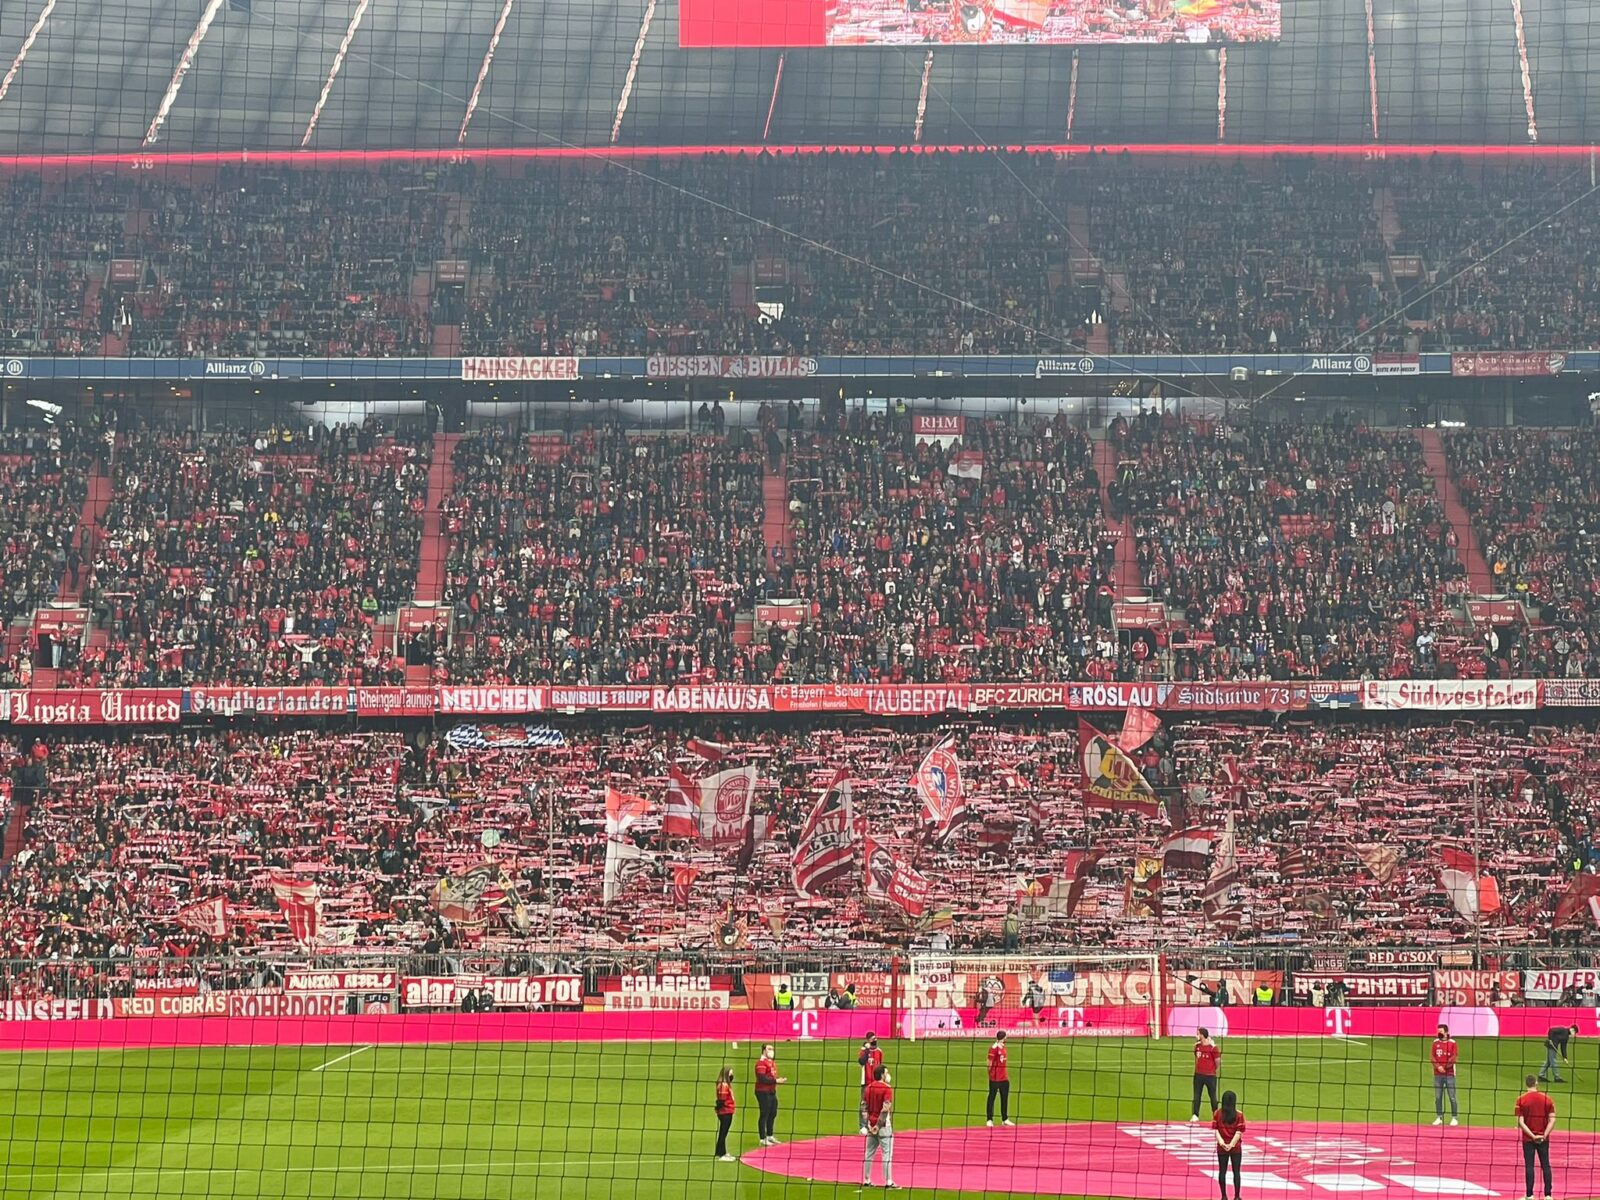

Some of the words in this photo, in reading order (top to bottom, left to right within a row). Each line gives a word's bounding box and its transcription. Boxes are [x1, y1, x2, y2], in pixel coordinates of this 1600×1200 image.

[206, 363, 247, 376] Allianz
[464, 359, 577, 379] HAINSACKER
[647, 359, 722, 376] GIESSEN
[749, 358, 809, 376] BULLS
[1037, 360, 1077, 373] Allianz
[1311, 358, 1351, 370] Allianz
[921, 416, 958, 428] RHM
[441, 690, 543, 710] MEUCHEN
[552, 690, 608, 704] BAMBULE
[611, 690, 650, 704] TRUPP
[653, 687, 770, 709] RABENAU/SA
[774, 687, 788, 698] FC
[791, 686, 826, 700] Bayern
[835, 685, 864, 697] Schar
[866, 688, 969, 711] TAUBERTAL
[975, 687, 1006, 703] BFC
[1010, 685, 1062, 703] ZÜRICH
[1083, 685, 1153, 706] RÖSLAU
[1178, 686, 1261, 706] Südkurve
[1397, 684, 1535, 708] Südwestfalen
[12, 692, 91, 723] Lipsia
[102, 692, 180, 722] United
[1369, 952, 1395, 963] RED
[845, 972, 885, 984] ULTRAS
[545, 979, 581, 1002] rot
[1437, 990, 1468, 1006] RED
[122, 998, 154, 1015] RED
[160, 996, 227, 1014] COBRAS
[612, 996, 643, 1010] RED
[931, 1029, 965, 1037] MAGENTA
